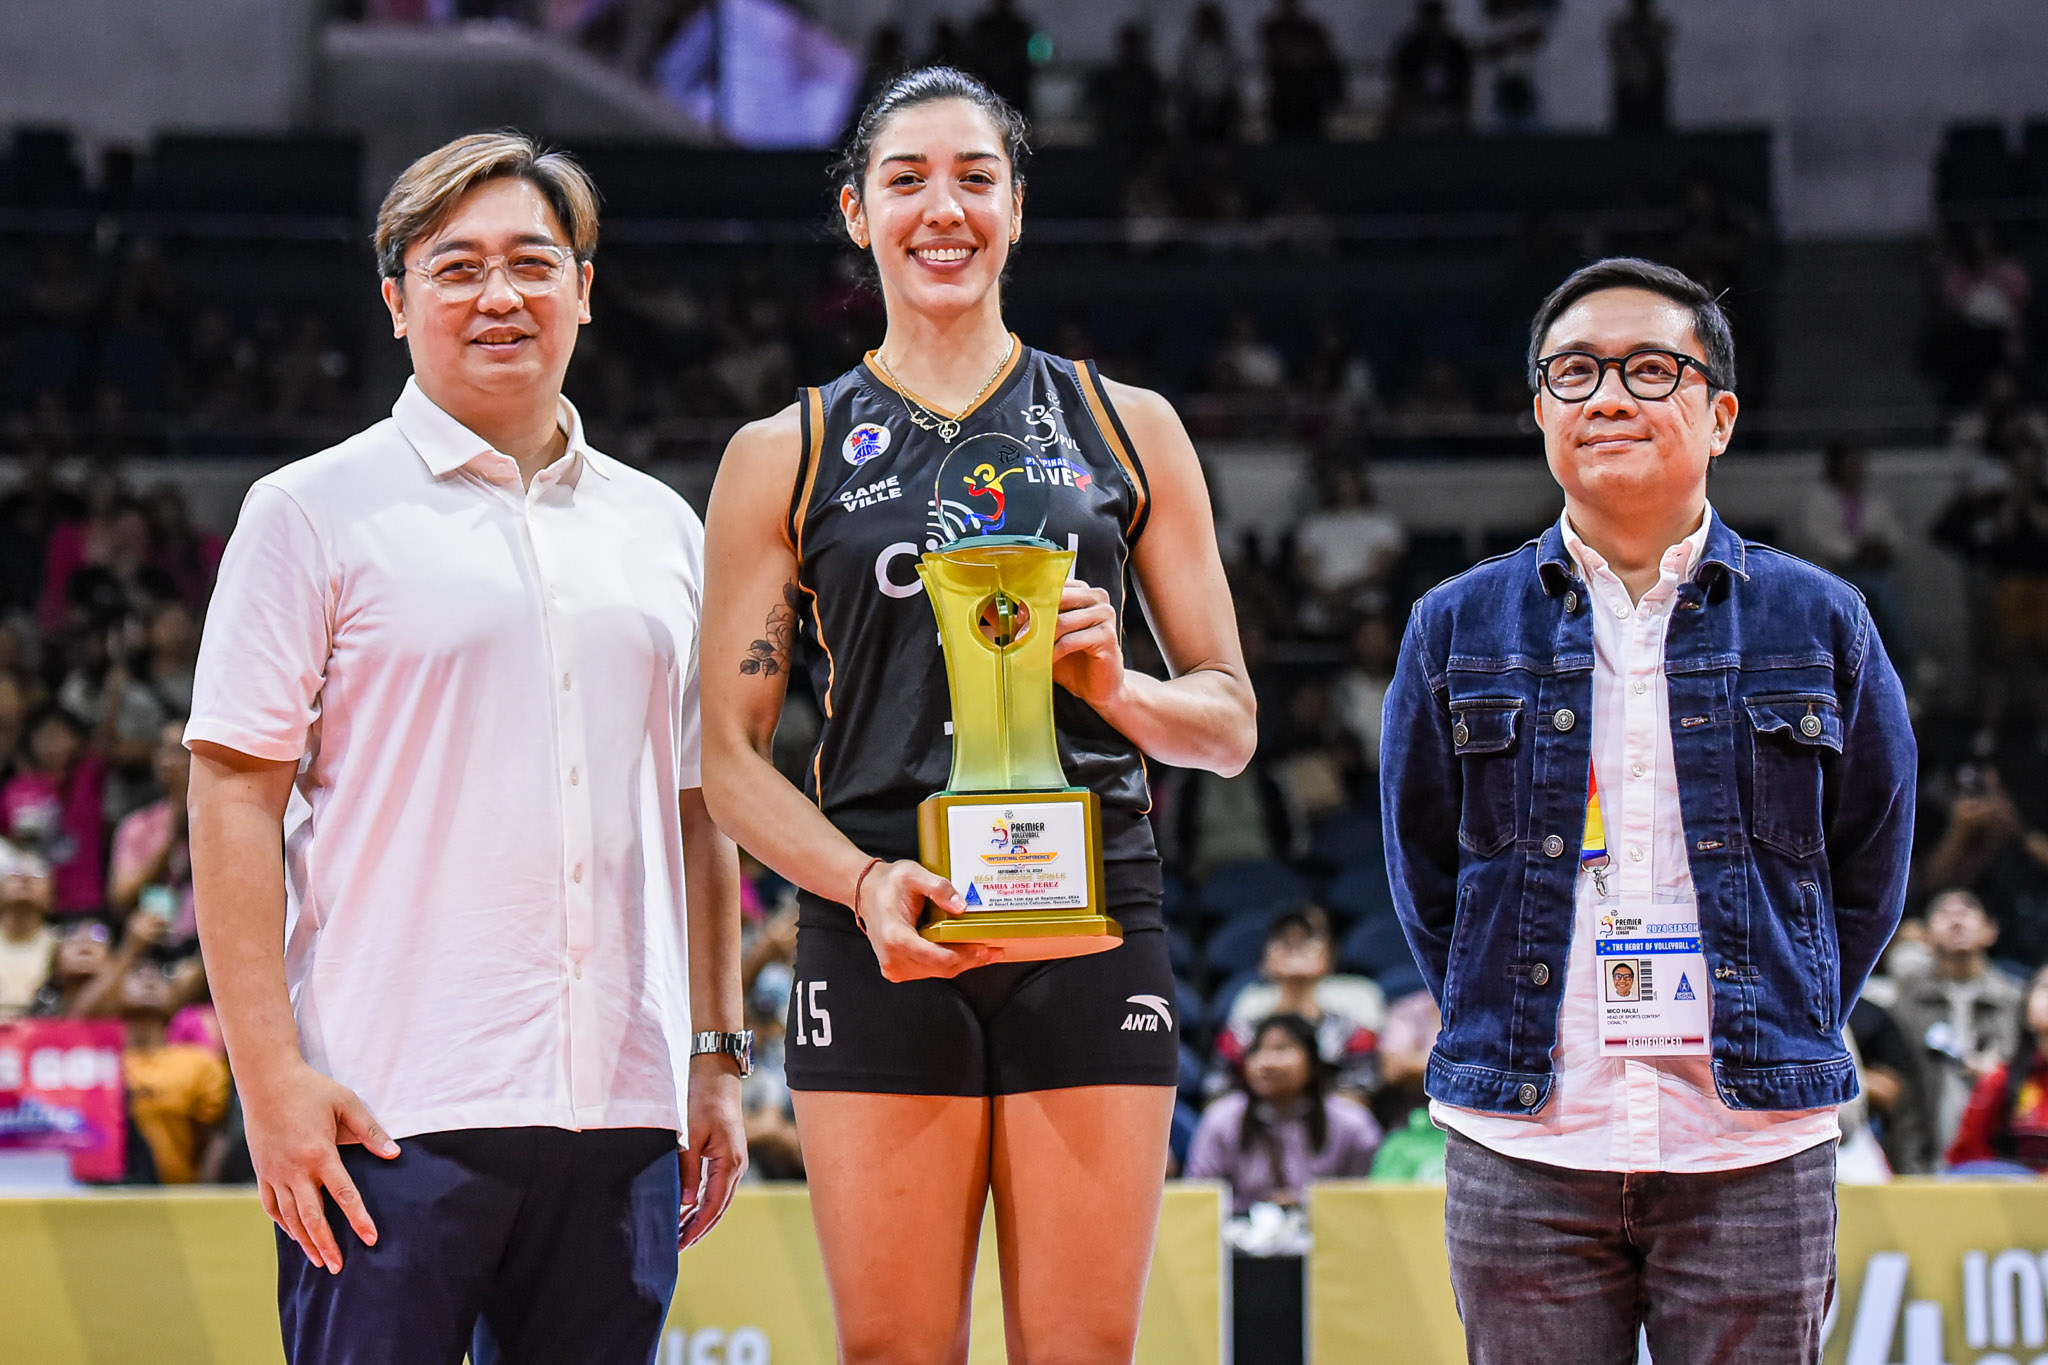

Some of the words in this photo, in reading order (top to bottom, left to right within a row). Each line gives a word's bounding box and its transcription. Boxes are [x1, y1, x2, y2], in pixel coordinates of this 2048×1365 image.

[1059, 433, 1081, 452] PVL
[1026, 457, 1070, 468] PIPINAS
[840, 475, 899, 502] GAME
[843, 487, 902, 513] VILLE
[1010, 822, 1045, 832] PREMIER
[1037, 872, 1066, 880] SPIKER
[1615, 918, 1642, 926] PREMIER
[1646, 923, 1667, 933] 2024
[1667, 922, 1698, 933] SEASON
[1612, 943, 1624, 951] THE
[1624, 942, 1643, 951] HEART
[1645, 942, 1652, 951] OF
[1653, 941, 1689, 950] VOLLEYBALL
[796, 980, 832, 1047] 15
[1120, 1013, 1158, 1032] ANTA
[1626, 1036, 1682, 1048] REINFORCED
[1963, 1248, 2048, 1350] IN
